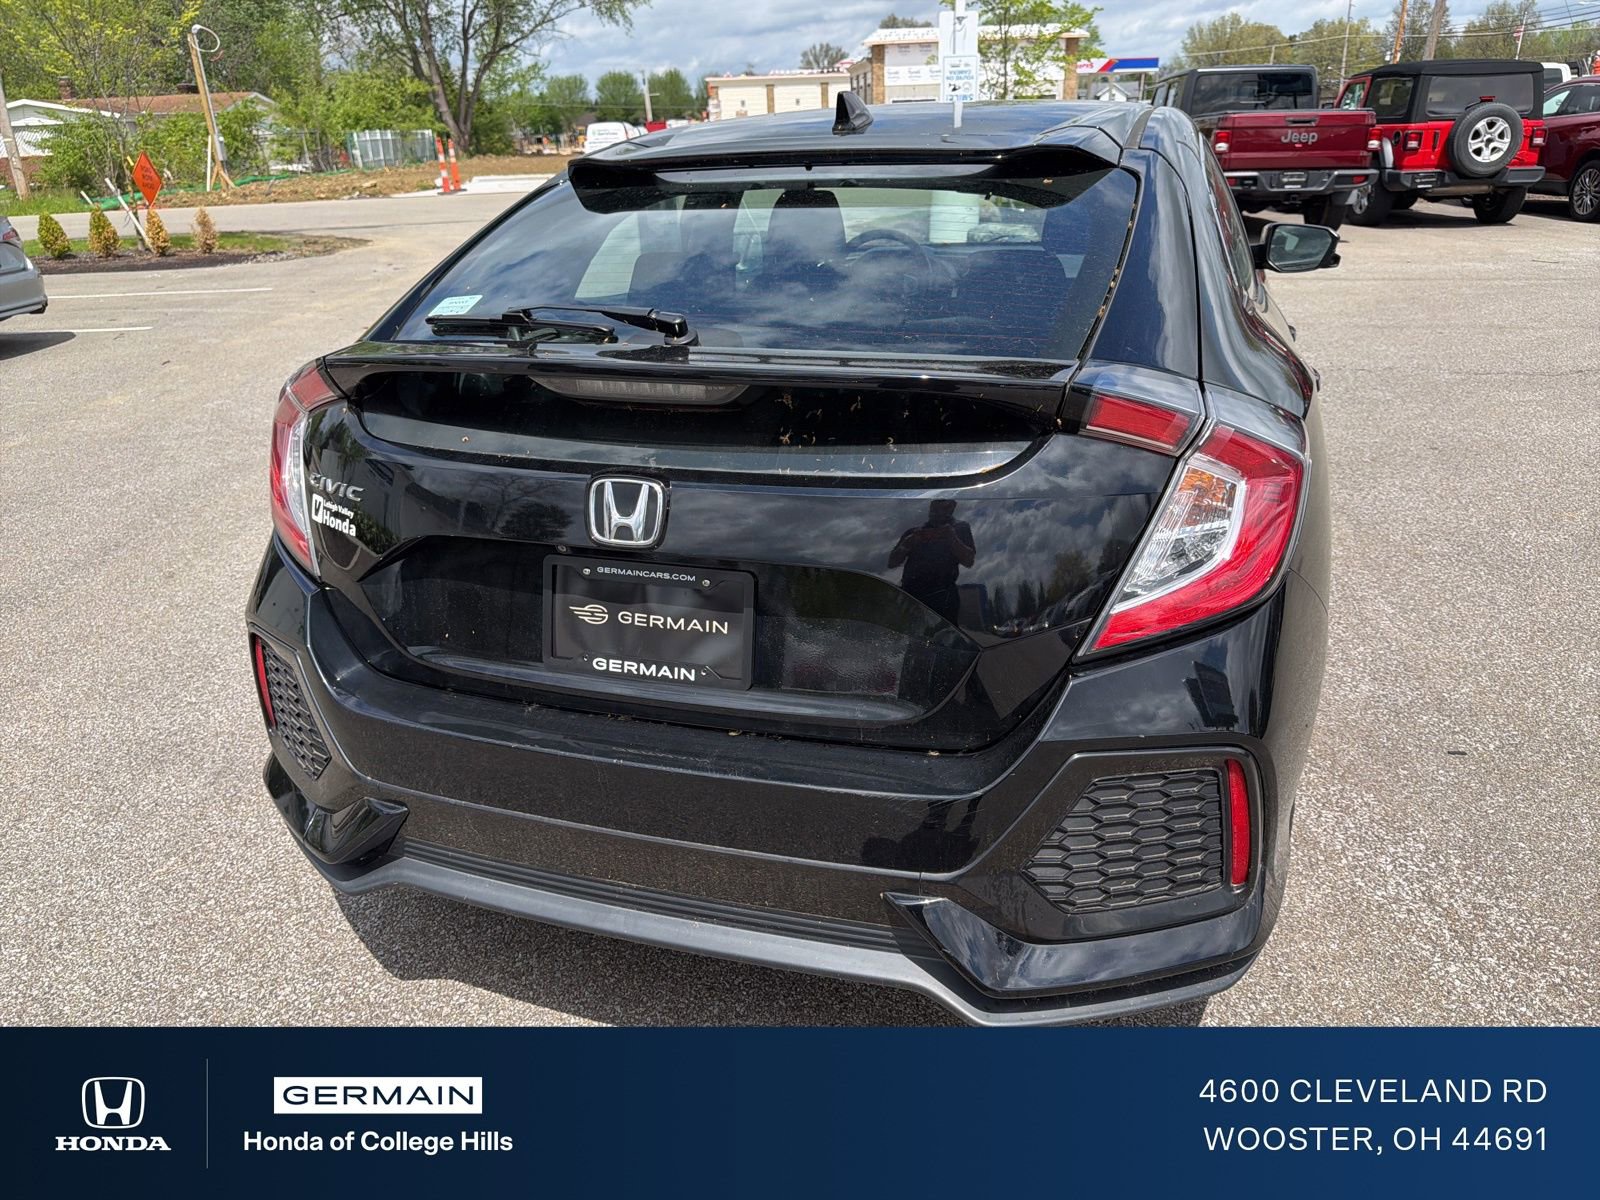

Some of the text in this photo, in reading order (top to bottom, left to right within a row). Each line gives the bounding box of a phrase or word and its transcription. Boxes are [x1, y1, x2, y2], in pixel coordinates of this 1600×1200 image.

[1281, 130, 1318, 145] Jeep
[310, 472, 365, 501] CIVIC
[323, 509, 356, 536] Honda
[338, 505, 354, 519] Valley
[597, 566, 696, 582] GERMAINCARS.COM
[617, 611, 729, 635] GERMAIN
[592, 657, 696, 682] GERMAIN
